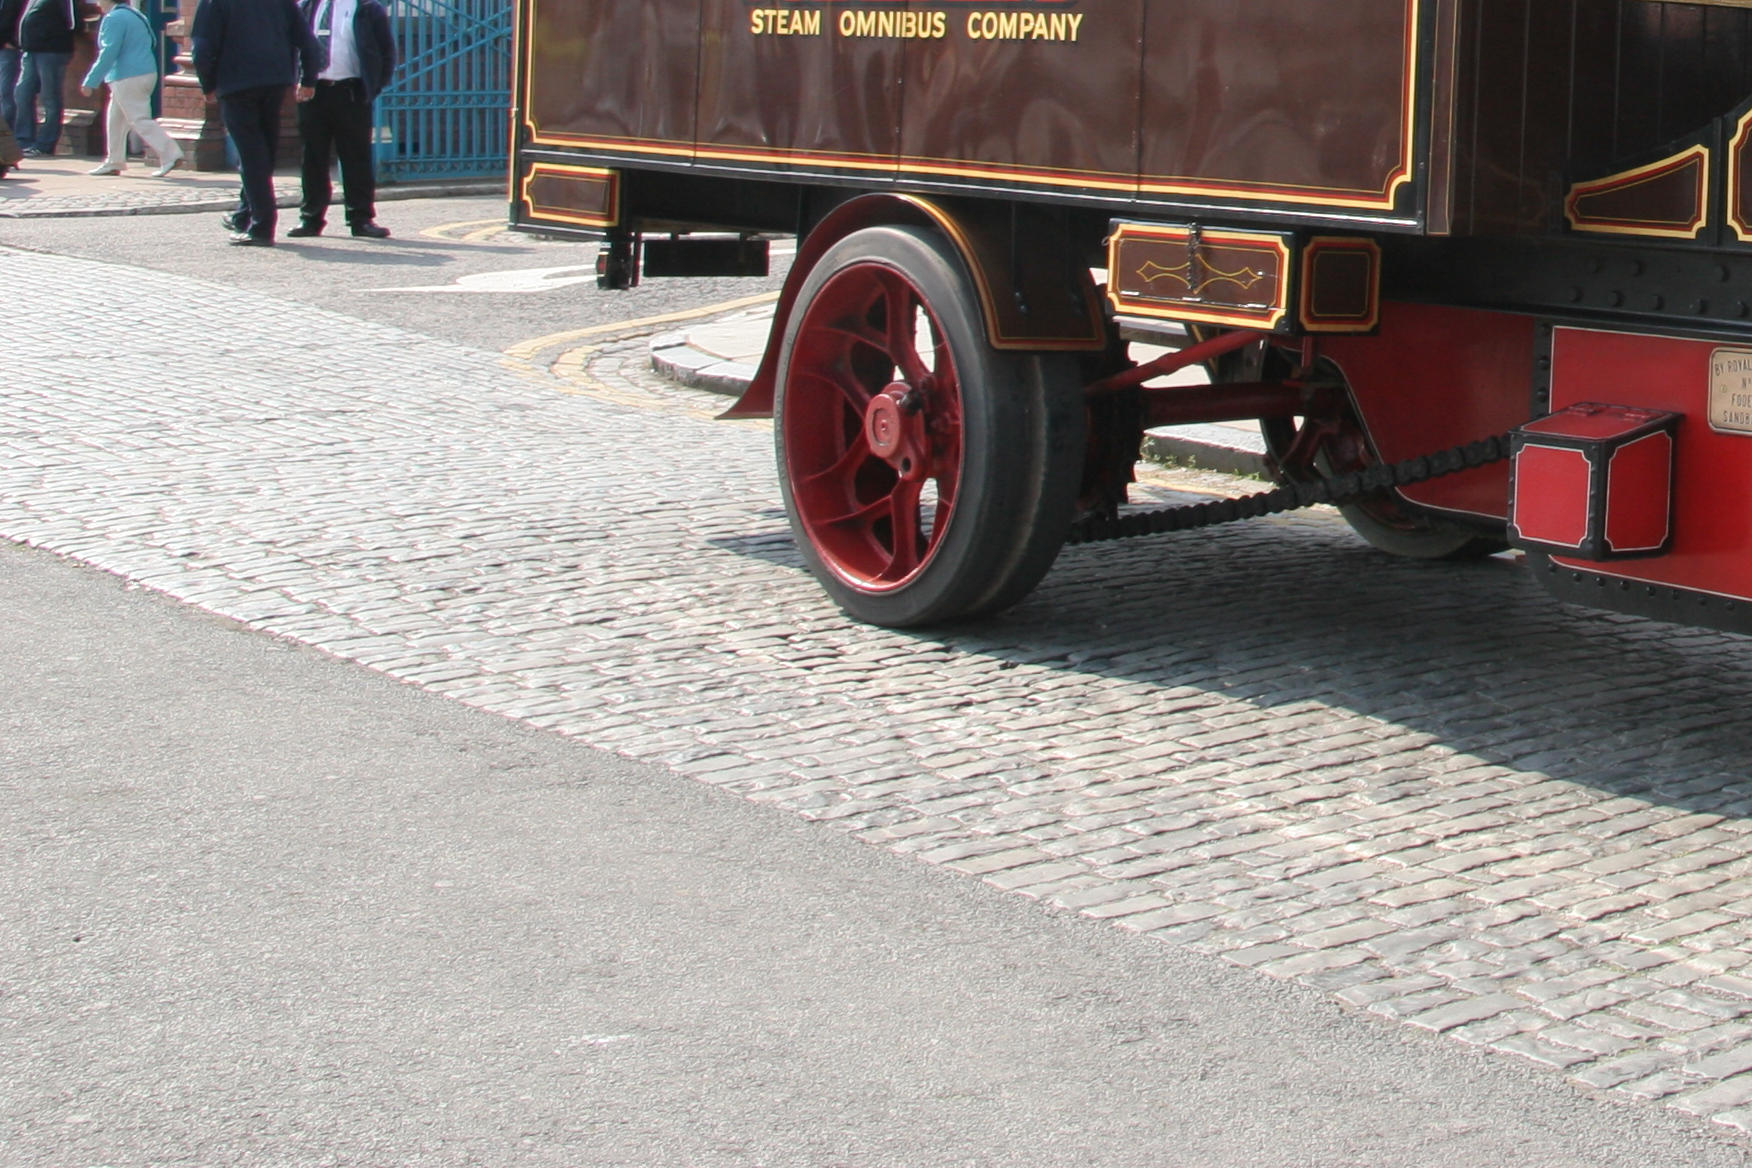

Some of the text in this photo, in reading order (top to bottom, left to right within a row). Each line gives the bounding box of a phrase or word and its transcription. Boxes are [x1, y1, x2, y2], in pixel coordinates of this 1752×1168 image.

[751, 9, 1083, 42] STEAM OMNIBUS COMPANY
[1714, 363, 1724, 377] BY
[1728, 359, 1752, 373] ROYAL
